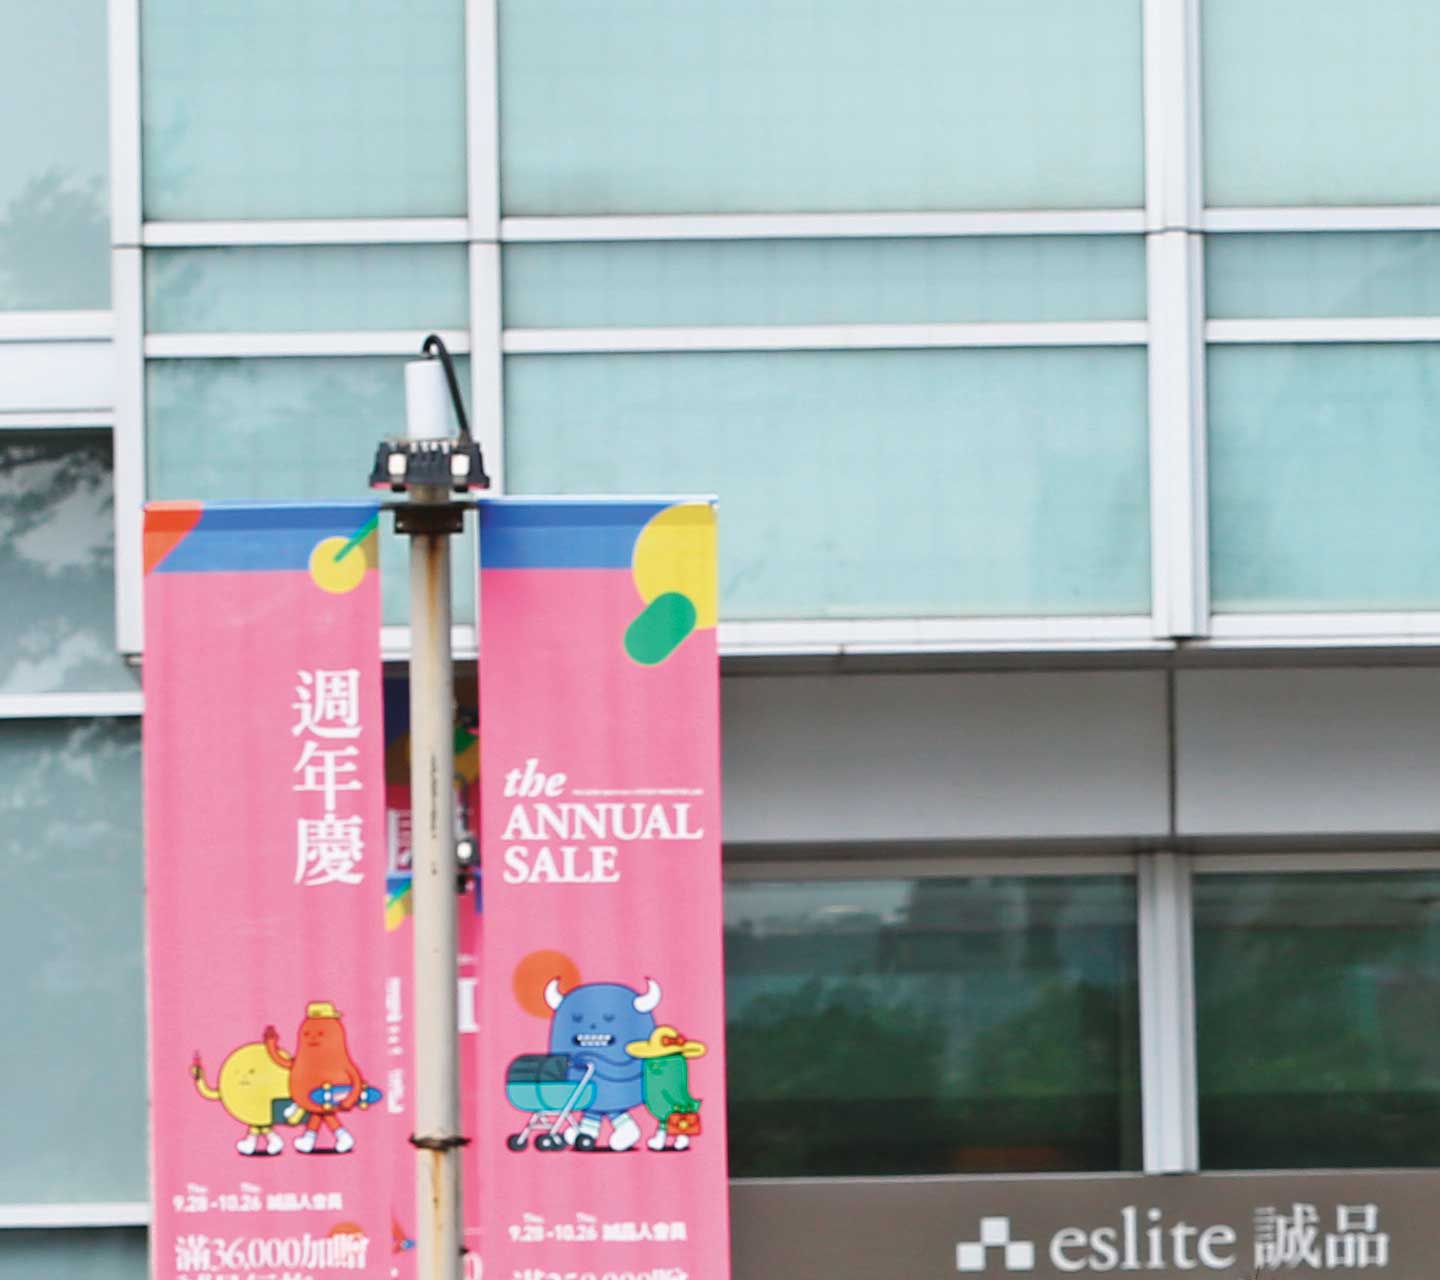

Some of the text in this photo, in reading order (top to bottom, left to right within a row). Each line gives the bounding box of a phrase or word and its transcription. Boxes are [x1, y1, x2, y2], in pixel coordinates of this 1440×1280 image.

[291, 668, 365, 886] 週年慶
[503, 758, 568, 798] the
[500, 803, 704, 841] ANNUAL
[503, 845, 620, 884] SALE
[1049, 1203, 1390, 1272] eslite 誠品
